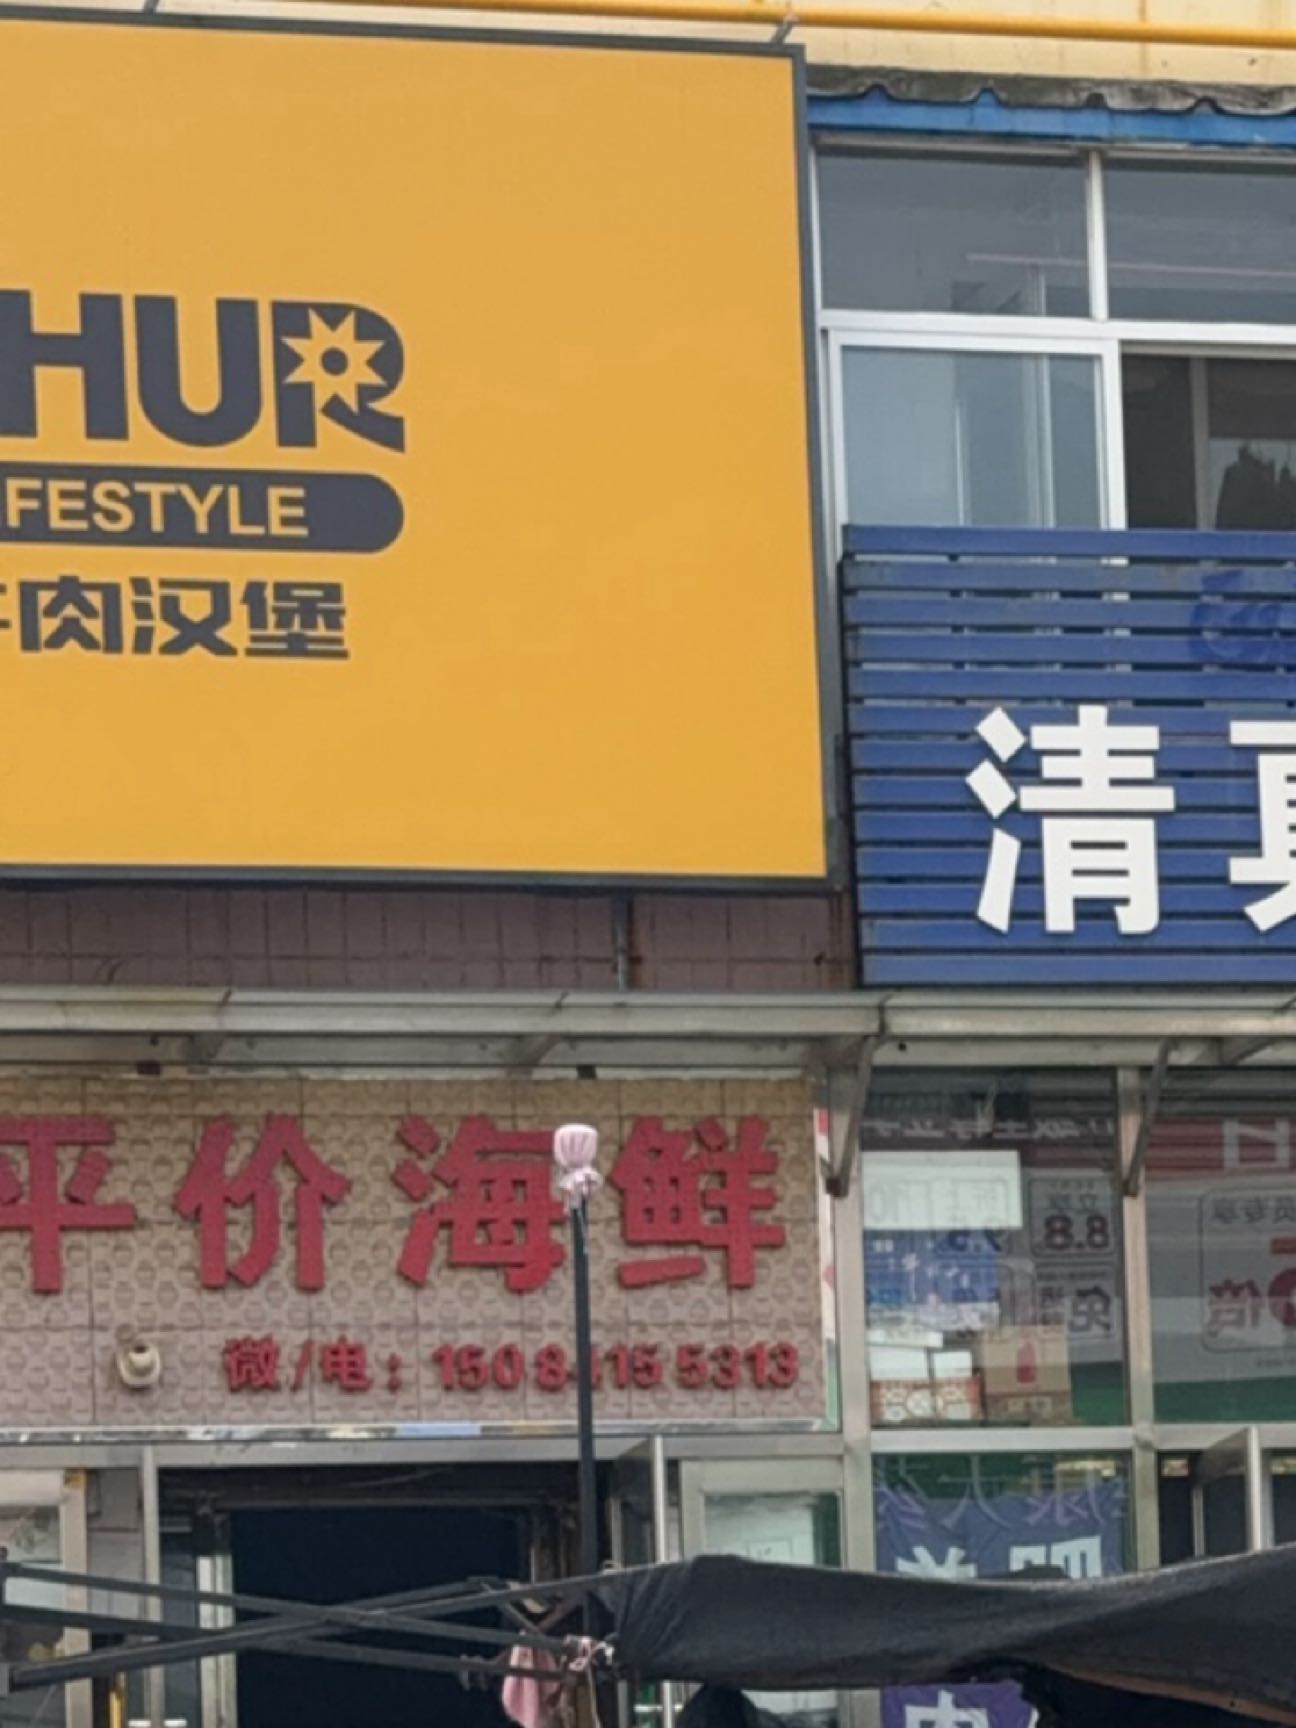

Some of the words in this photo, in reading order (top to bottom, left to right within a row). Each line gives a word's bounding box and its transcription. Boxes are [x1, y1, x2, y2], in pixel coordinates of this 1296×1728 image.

[5, 476, 309, 538] FESTYLE
[0, 575, 350, 661] 肉汉堡
[0, 1113, 786, 1294] 平价海鲜
